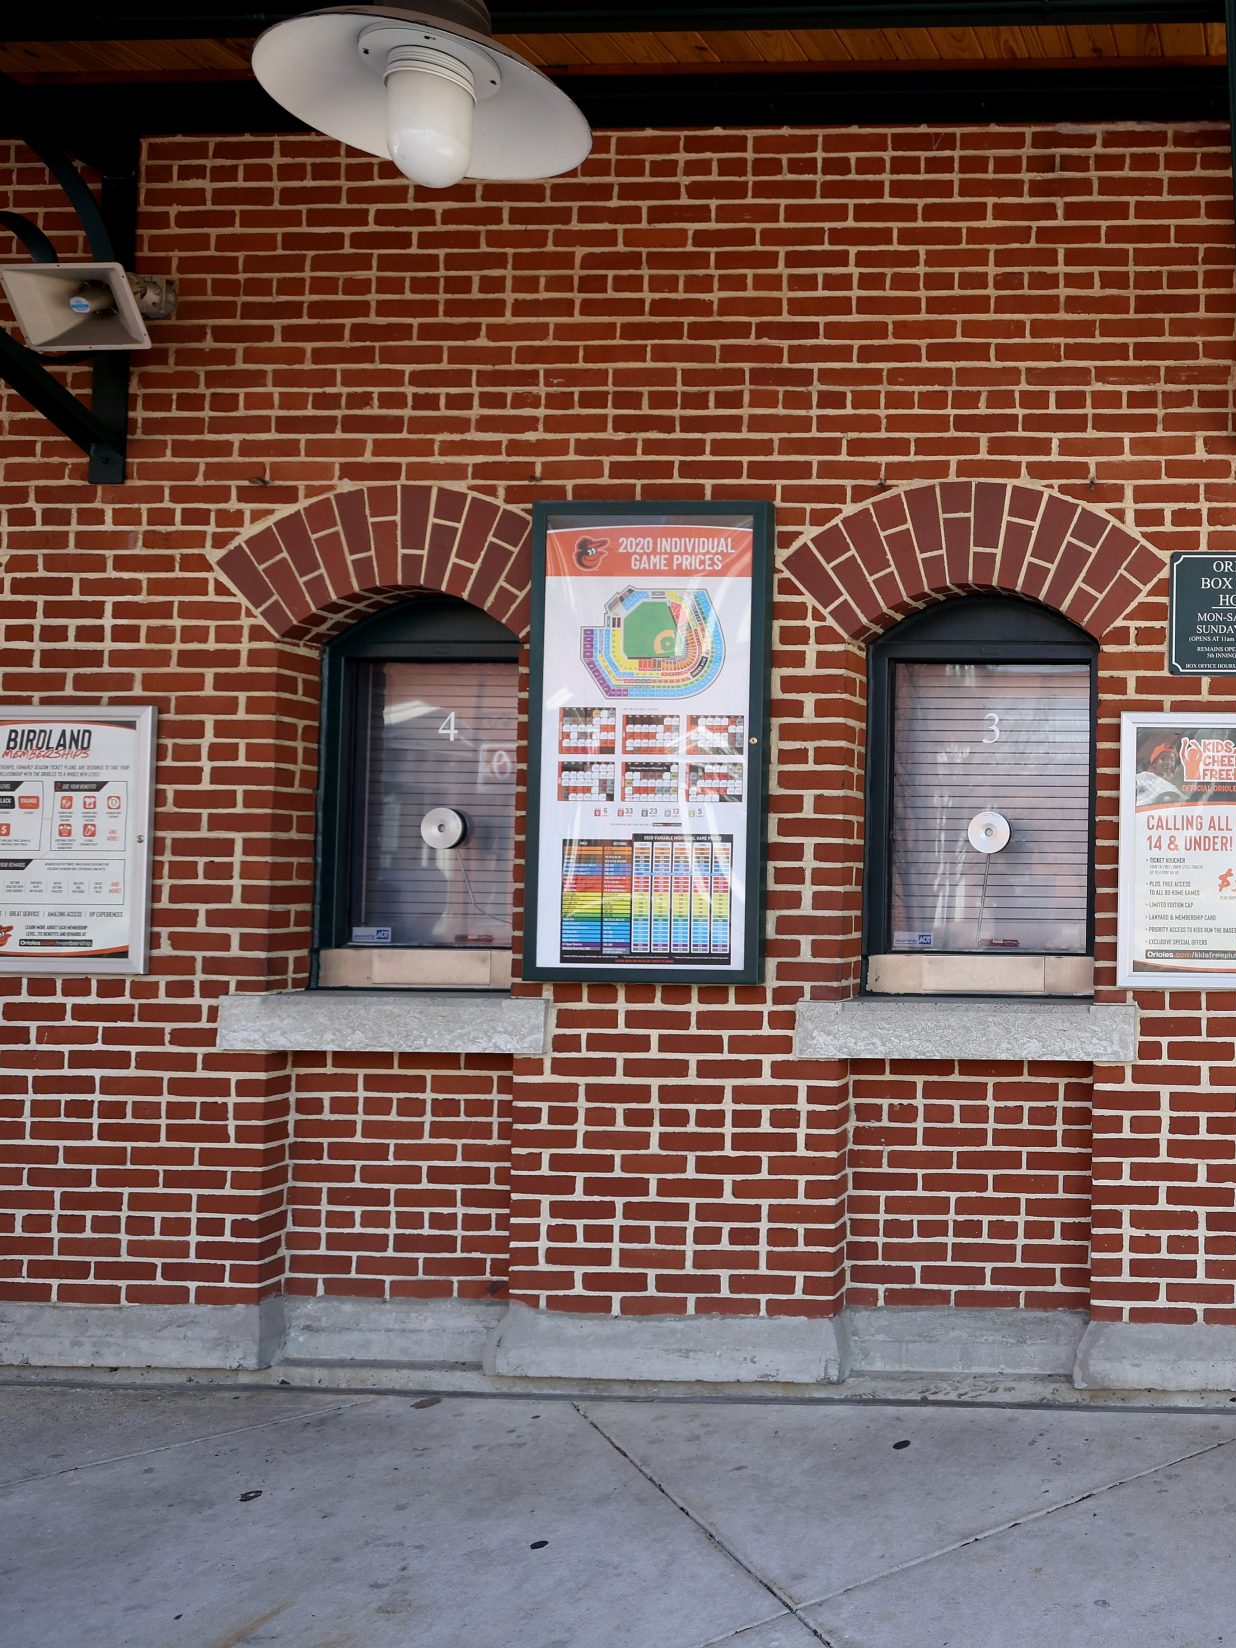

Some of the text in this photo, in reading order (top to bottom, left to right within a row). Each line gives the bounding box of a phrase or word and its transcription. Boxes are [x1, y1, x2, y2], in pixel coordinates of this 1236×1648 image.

[619, 537, 735, 552] 2020 INDIVIDUAL
[631, 555, 723, 570] GAME PRICES
[1201, 577, 1232, 589] BOX
[438, 711, 458, 742] 4
[982, 712, 1001, 744] 3
[6, 729, 92, 750] BIRDLAND
[1203, 741, 1233, 753] KIDS
[1, 749, 91, 760] MEMBERSHIPS
[1203, 769, 1233, 780] FREE
[1146, 815, 1203, 831] CALLING
[1208, 815, 1232, 831] ALL
[1146, 835, 1233, 851] 14 & UNDER!
[377, 930, 389, 939] ADT
[920, 935, 931, 943] ADT
